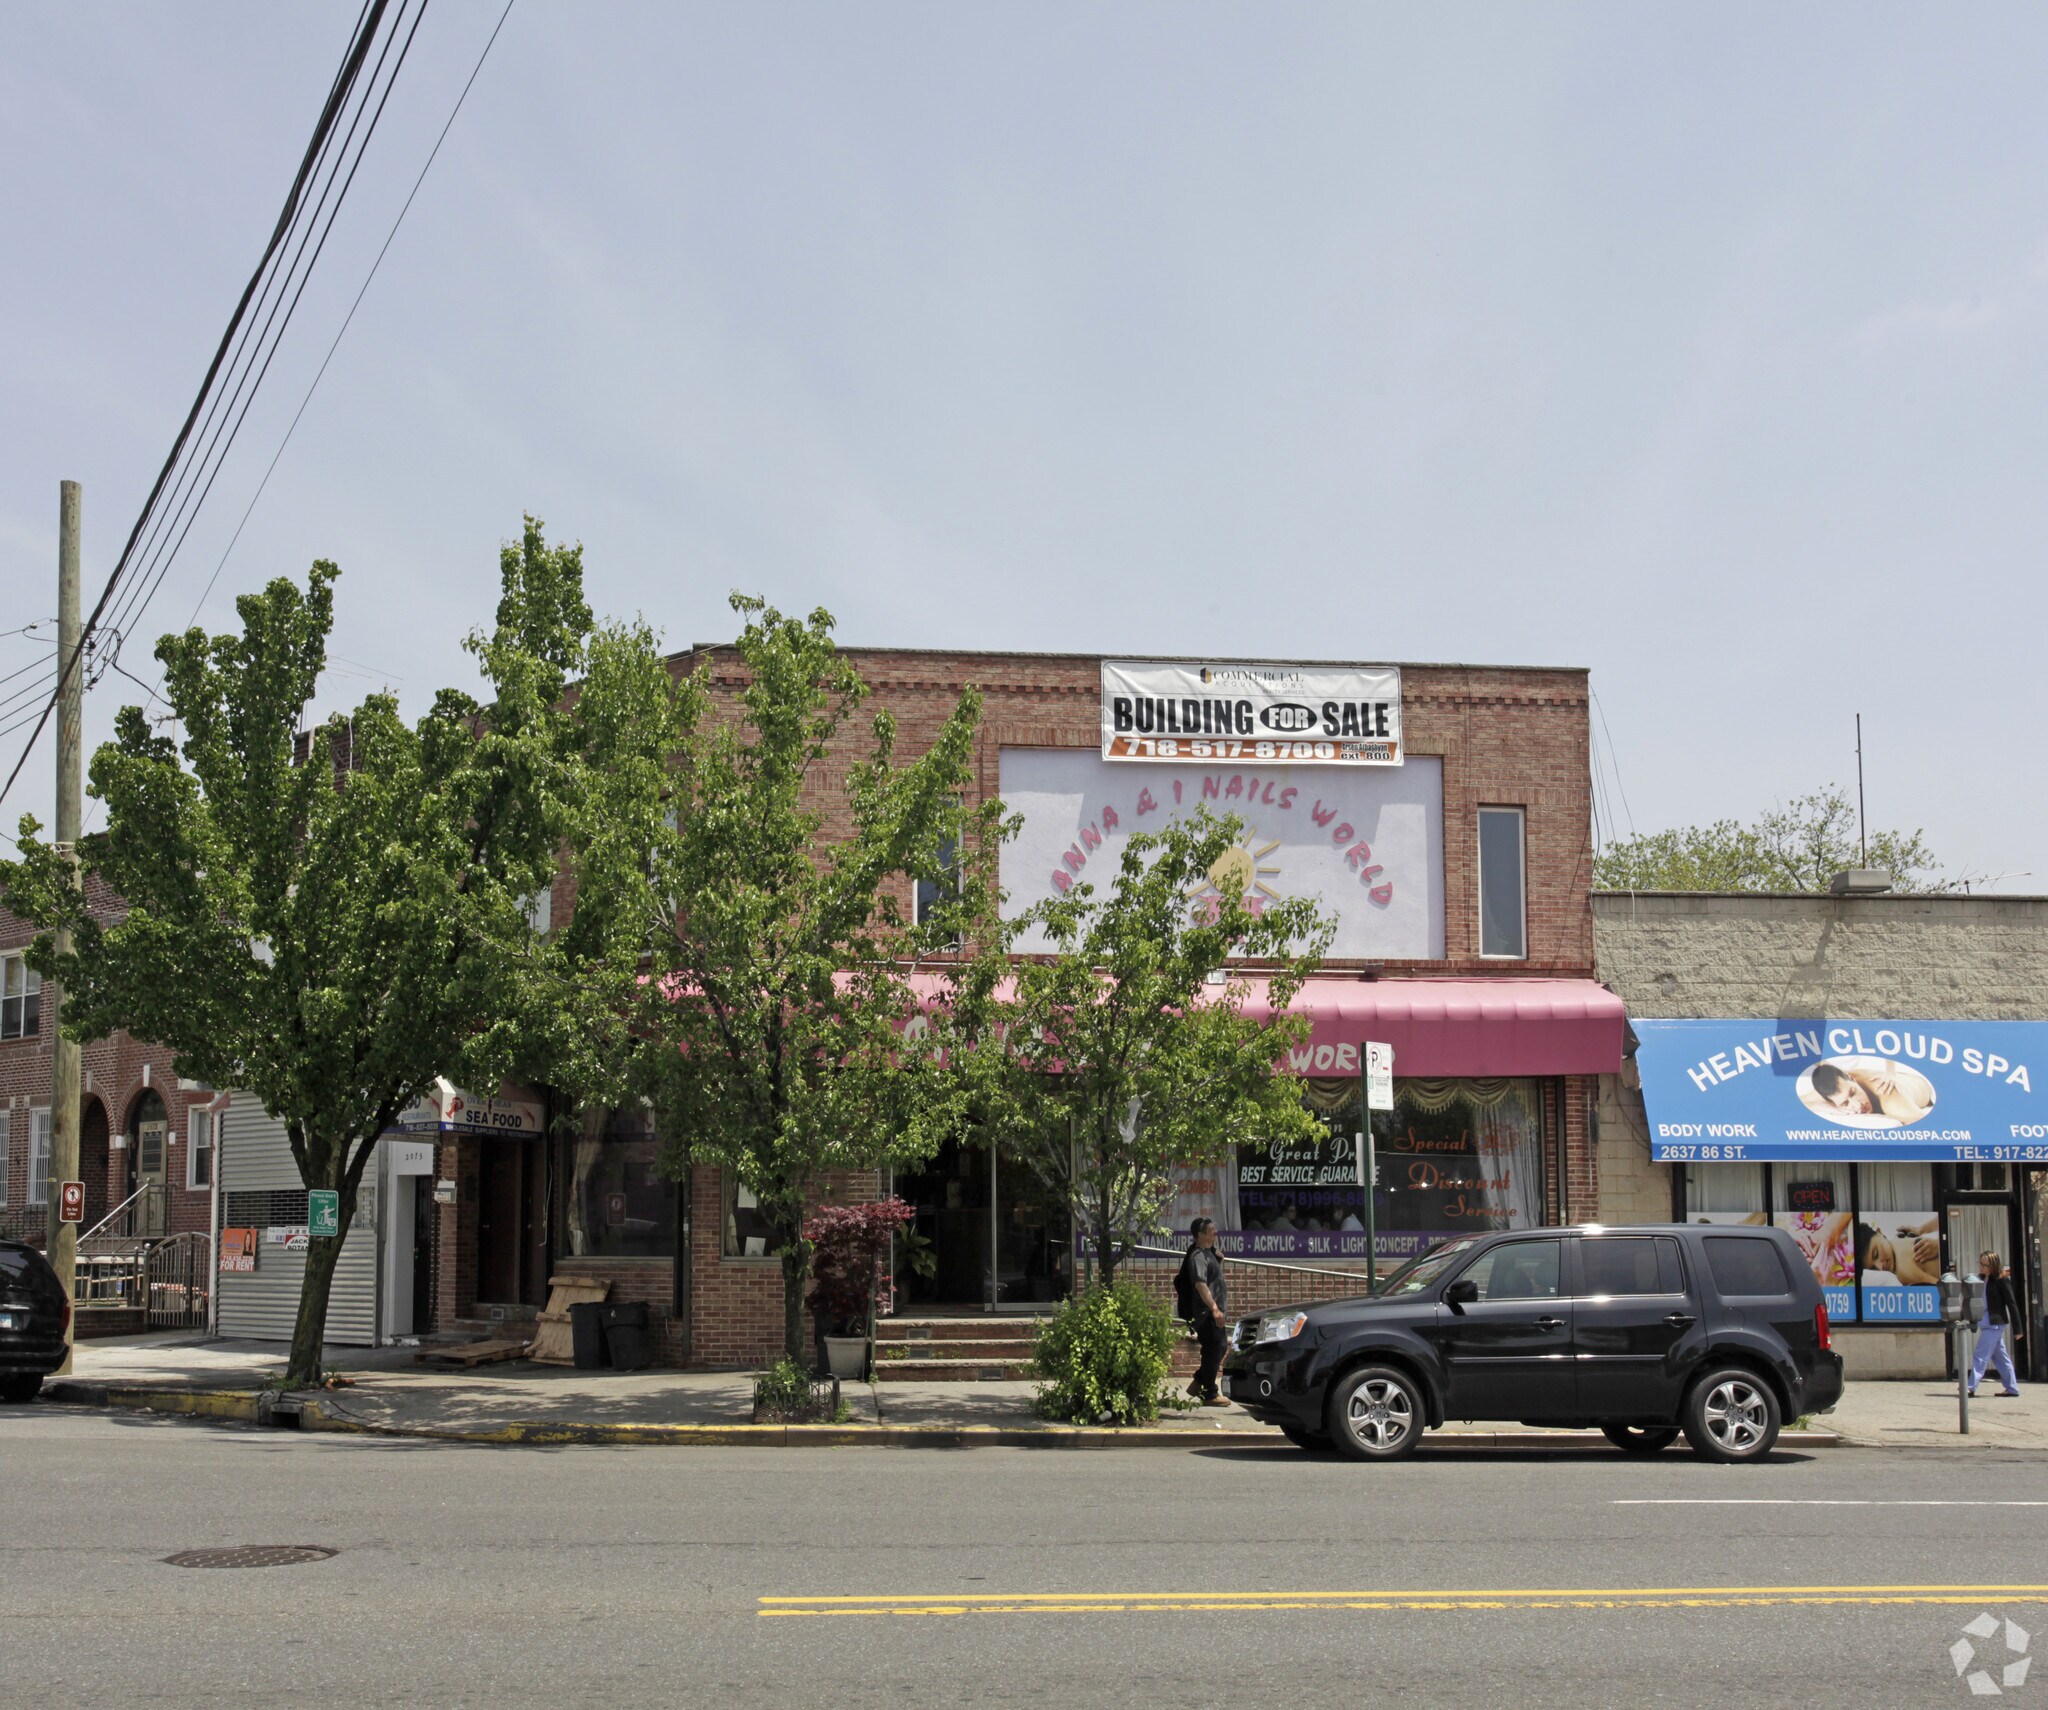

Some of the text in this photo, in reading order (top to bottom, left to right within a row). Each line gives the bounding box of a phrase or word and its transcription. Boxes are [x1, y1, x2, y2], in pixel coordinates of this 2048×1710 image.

[1213, 670, 1304, 682] COMMERCIAL
[1214, 680, 1304, 689] ACQUISITIONS
[1113, 697, 1390, 737] BUILDING FOR SALE
[1123, 738, 1335, 759] 718-517-8700
[1366, 752, 1390, 760] 800
[1051, 805, 1119, 891] ANNA
[1137, 787, 1158, 815] &
[1203, 774, 1298, 809] NAILS
[1311, 800, 1393, 905] WORLD
[1687, 1028, 2032, 1093] HEAVEN CLOUD SPA
[445, 1123, 473, 1133] WHOLESALE
[466, 1110, 522, 1128] SEA FOOD
[1393, 1126, 1469, 1153] Special
[1658, 1123, 1703, 1137] BODY
[1706, 1123, 1758, 1137] WORK
[1785, 1129, 1972, 1141] WWW.HEAVENCLOUDSPA.COM
[1269, 1138, 1320, 1165] Great
[1660, 1145, 1747, 1159] 2637 86 ST.
[1953, 1146, 1989, 1160] TEL:
[1240, 1165, 1381, 1183] BEST SERVICE GUARAE
[1408, 1161, 1511, 1191] Discount
[1178, 1179, 1217, 1195] COMBO
[1443, 1194, 1518, 1217] Service
[1793, 1189, 1831, 1204] OPEN
[1141, 1235, 1194, 1251] MANICURE
[1213, 1235, 1244, 1252] AXING
[1253, 1235, 1295, 1252] ACRYLIC
[1308, 1236, 1331, 1253] SILK
[1374, 1236, 1419, 1253] CONCEPT
[219, 1260, 254, 1271] FOR RENT
[1870, 1293, 1903, 1313] FOOT
[1908, 1293, 1933, 1313] RUB
